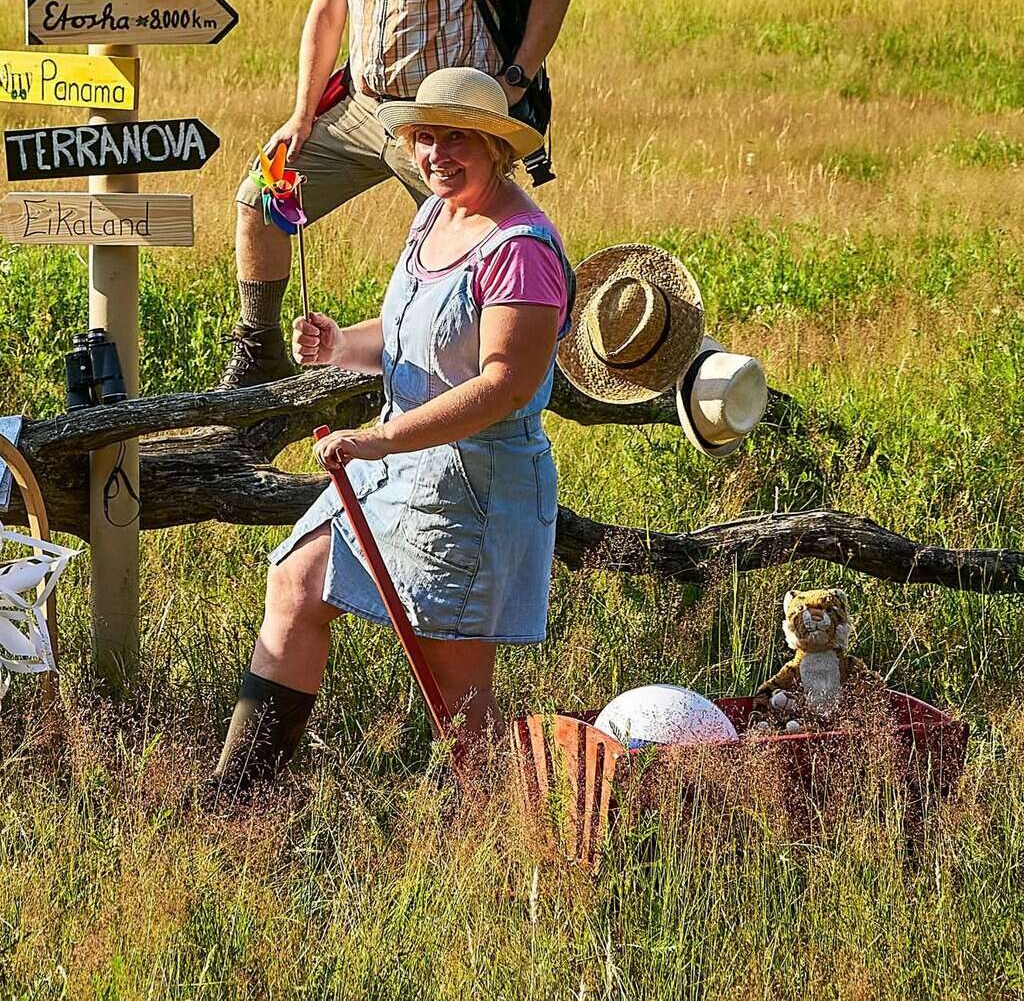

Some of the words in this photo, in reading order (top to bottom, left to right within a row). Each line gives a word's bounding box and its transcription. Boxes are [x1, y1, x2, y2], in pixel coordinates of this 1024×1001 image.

[42, 1, 129, 31] Etosha
[41, 59, 125, 104] Panama
[6, 121, 207, 172] TERRANOVA
